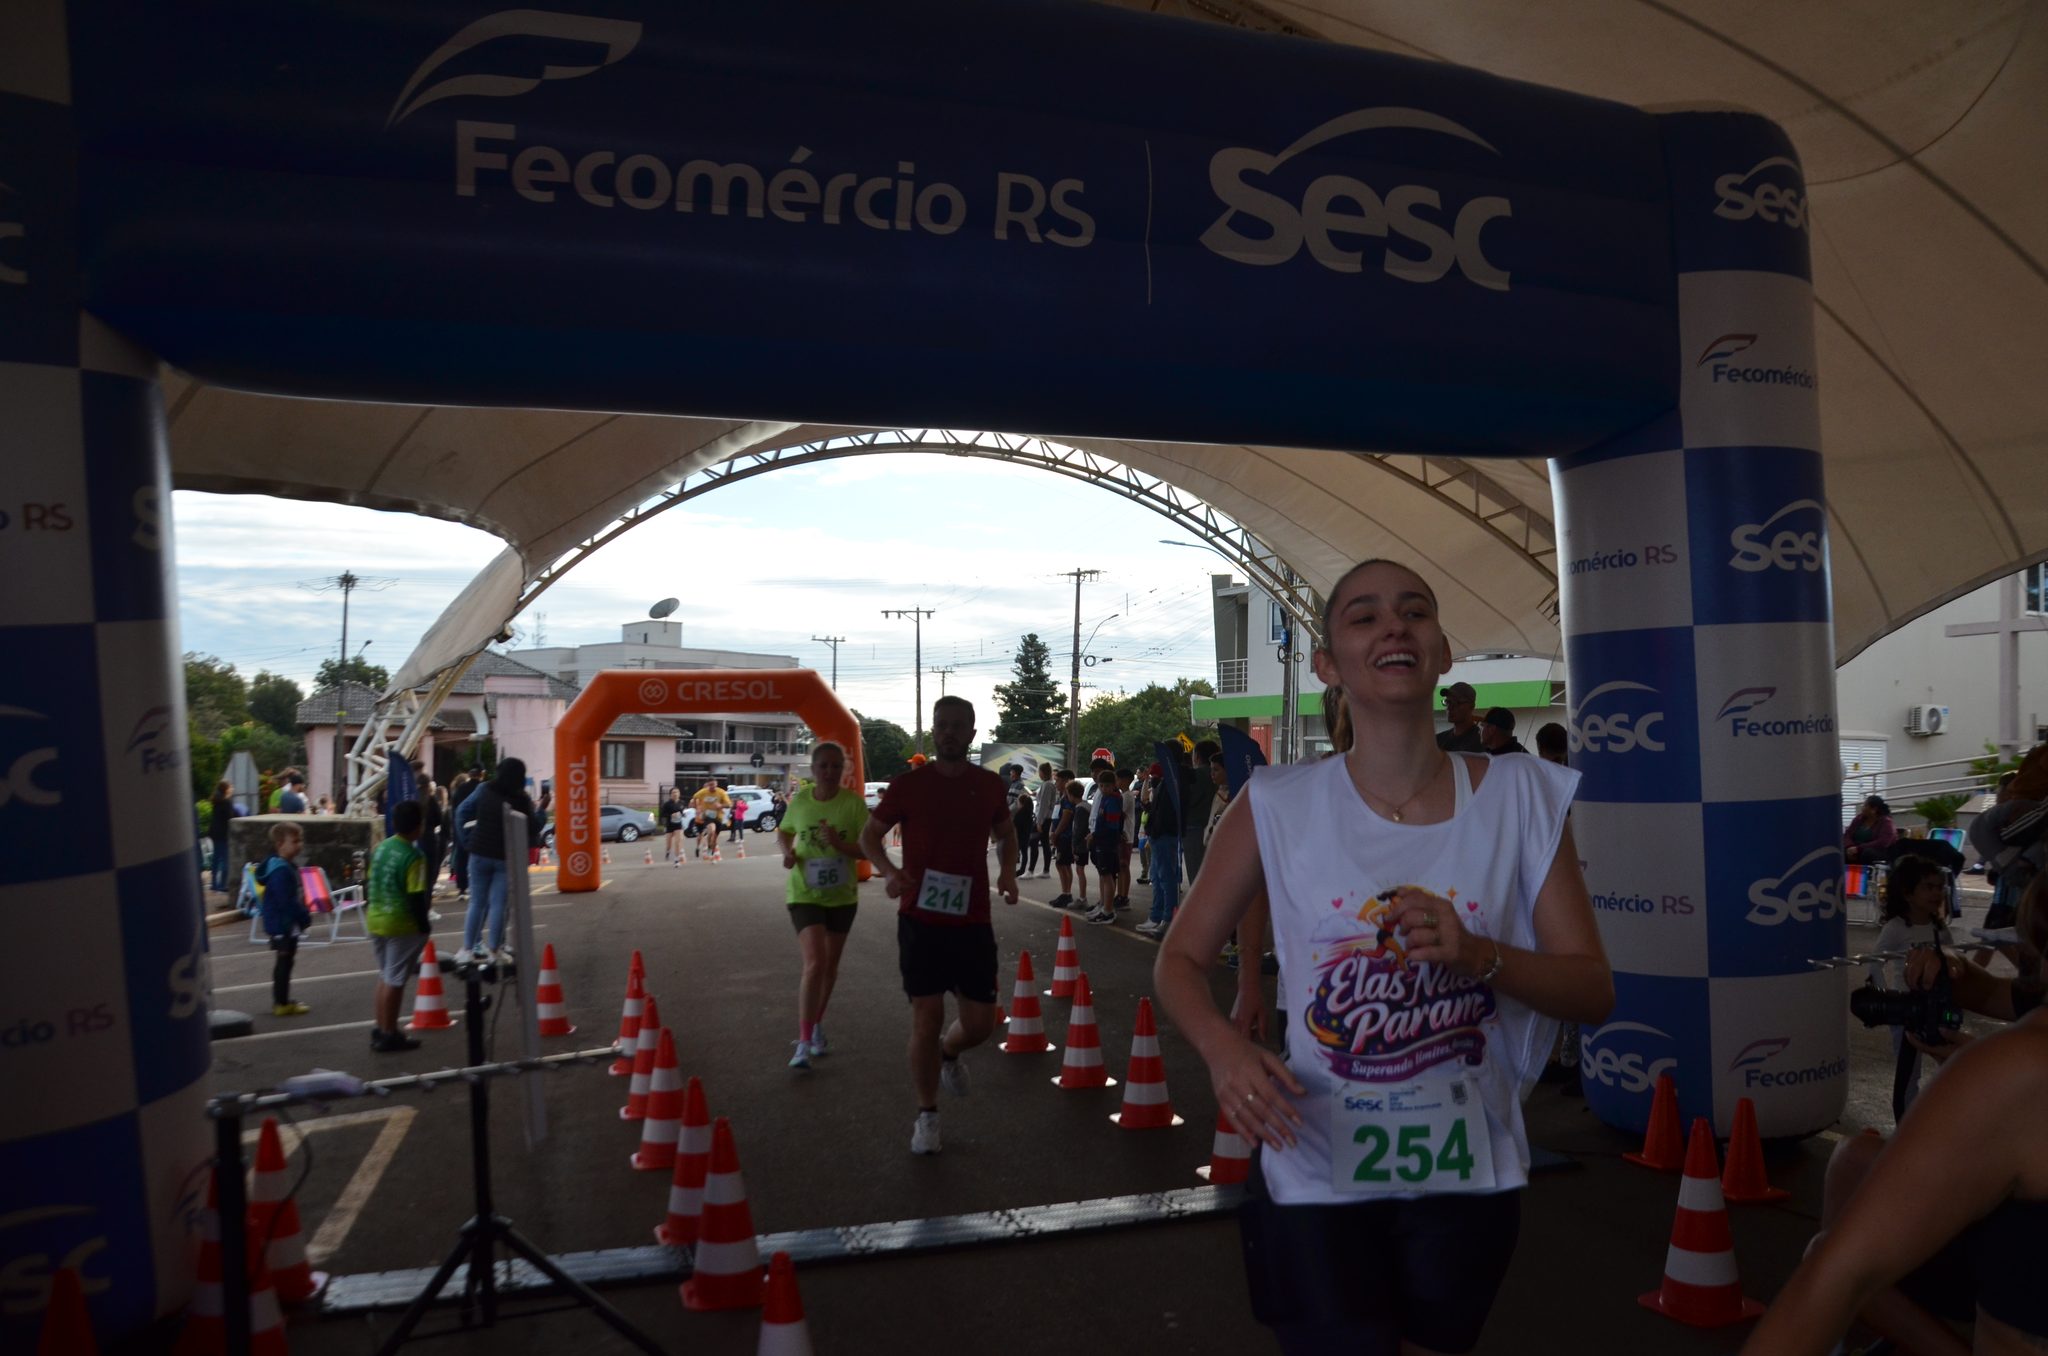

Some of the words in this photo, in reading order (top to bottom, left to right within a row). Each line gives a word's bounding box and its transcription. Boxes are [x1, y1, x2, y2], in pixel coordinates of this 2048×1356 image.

[455, 120, 967, 235] Fecomércio
[994, 172, 1097, 248] RS
[1199, 147, 1513, 291] Sesc
[24, 503, 73, 531] RS
[1644, 544, 1678, 565] RS
[677, 680, 782, 700] CRESOL
[568, 755, 588, 845] CRESOL
[817, 868, 838, 886] 56
[924, 885, 965, 912] 214
[1592, 891, 1654, 913] mércio
[1662, 896, 1695, 914] RS
[1326, 955, 1406, 1015] Elas
[66, 1004, 114, 1037] RS
[1344, 1096, 1384, 1112] Sesc
[1352, 1117, 1475, 1182] 254
